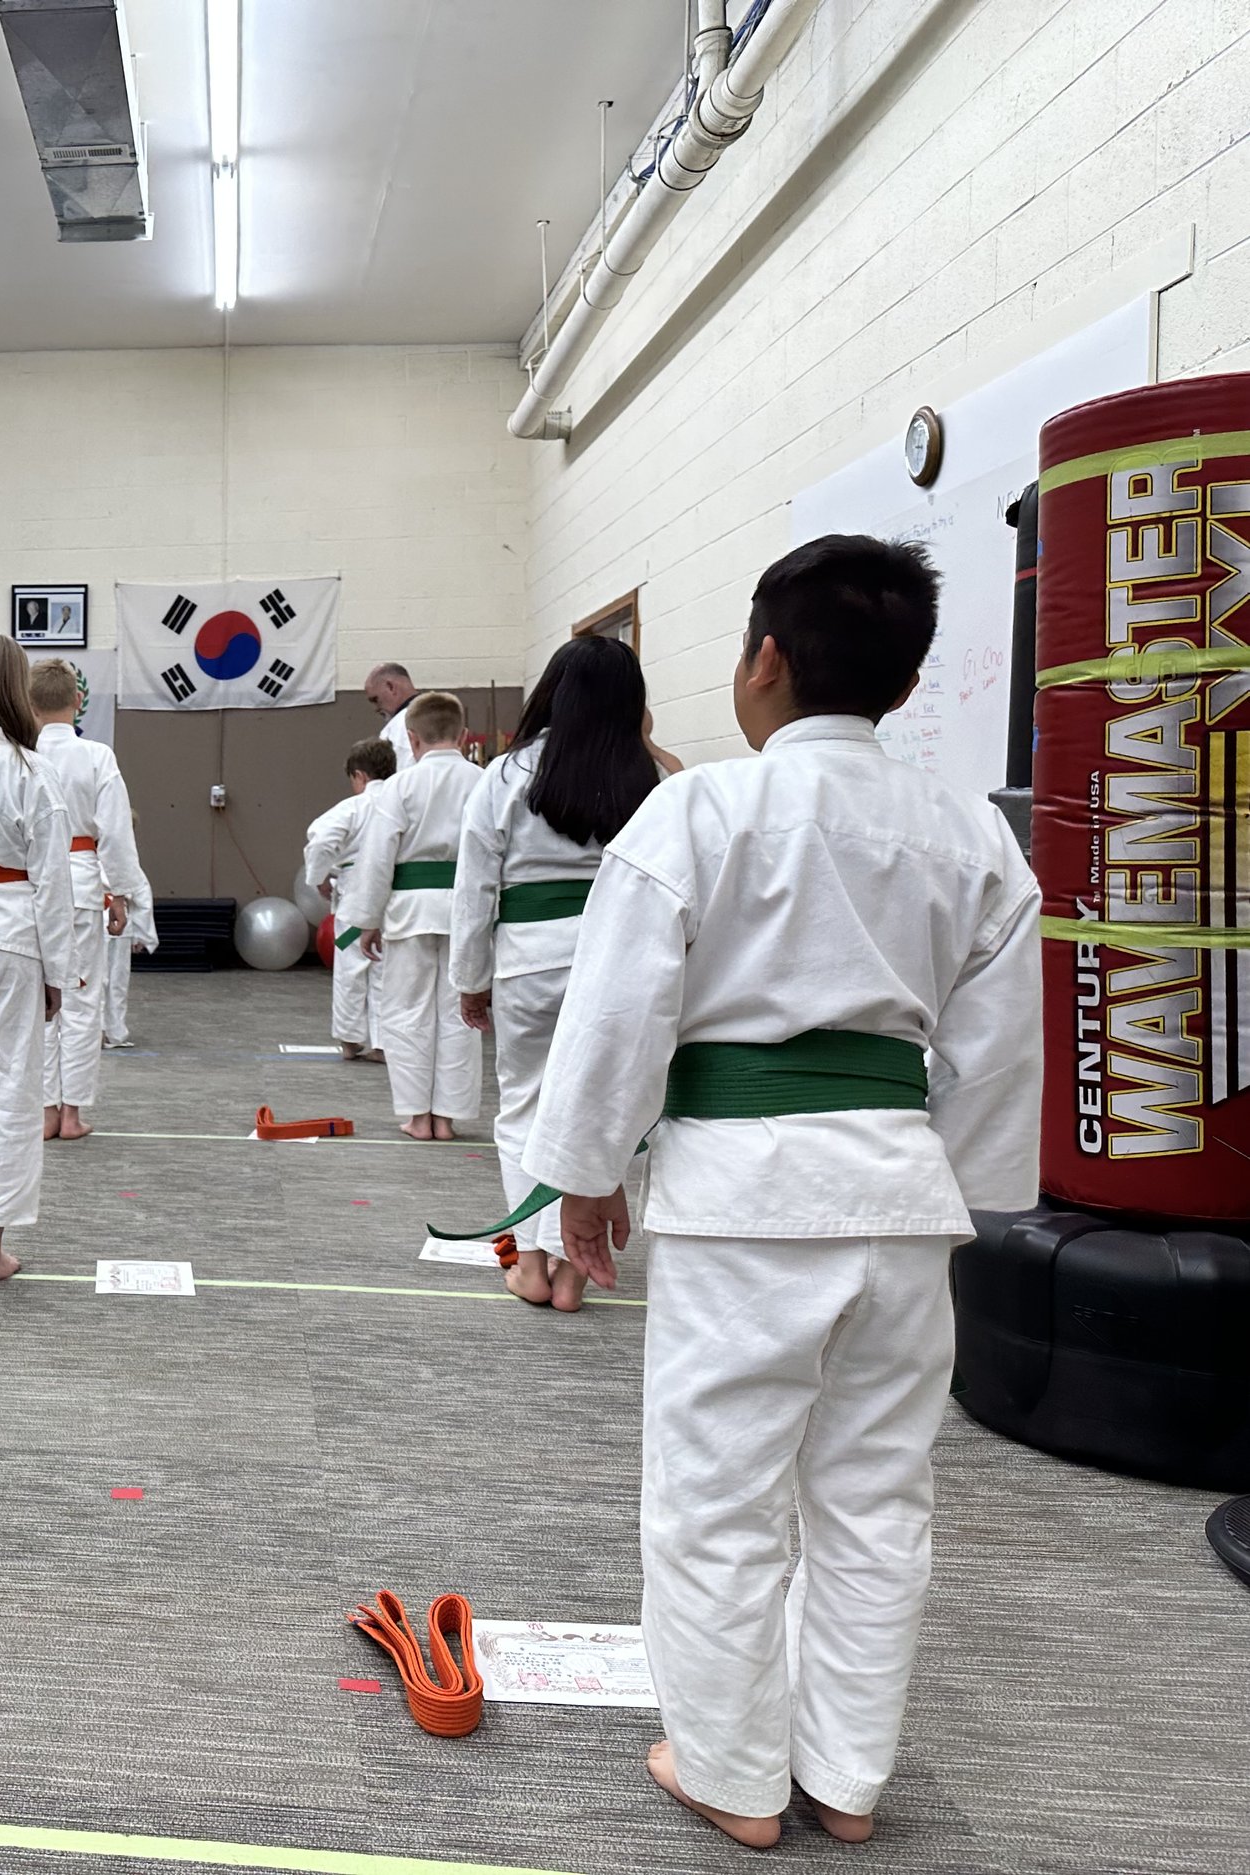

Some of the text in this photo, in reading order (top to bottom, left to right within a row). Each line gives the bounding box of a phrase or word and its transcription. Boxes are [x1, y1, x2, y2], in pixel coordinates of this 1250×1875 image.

[1090, 770, 1100, 884] Made in USA
[1105, 444, 1203, 1160] WAVEMASTER
[1076, 897, 1102, 1154] CENTURY
